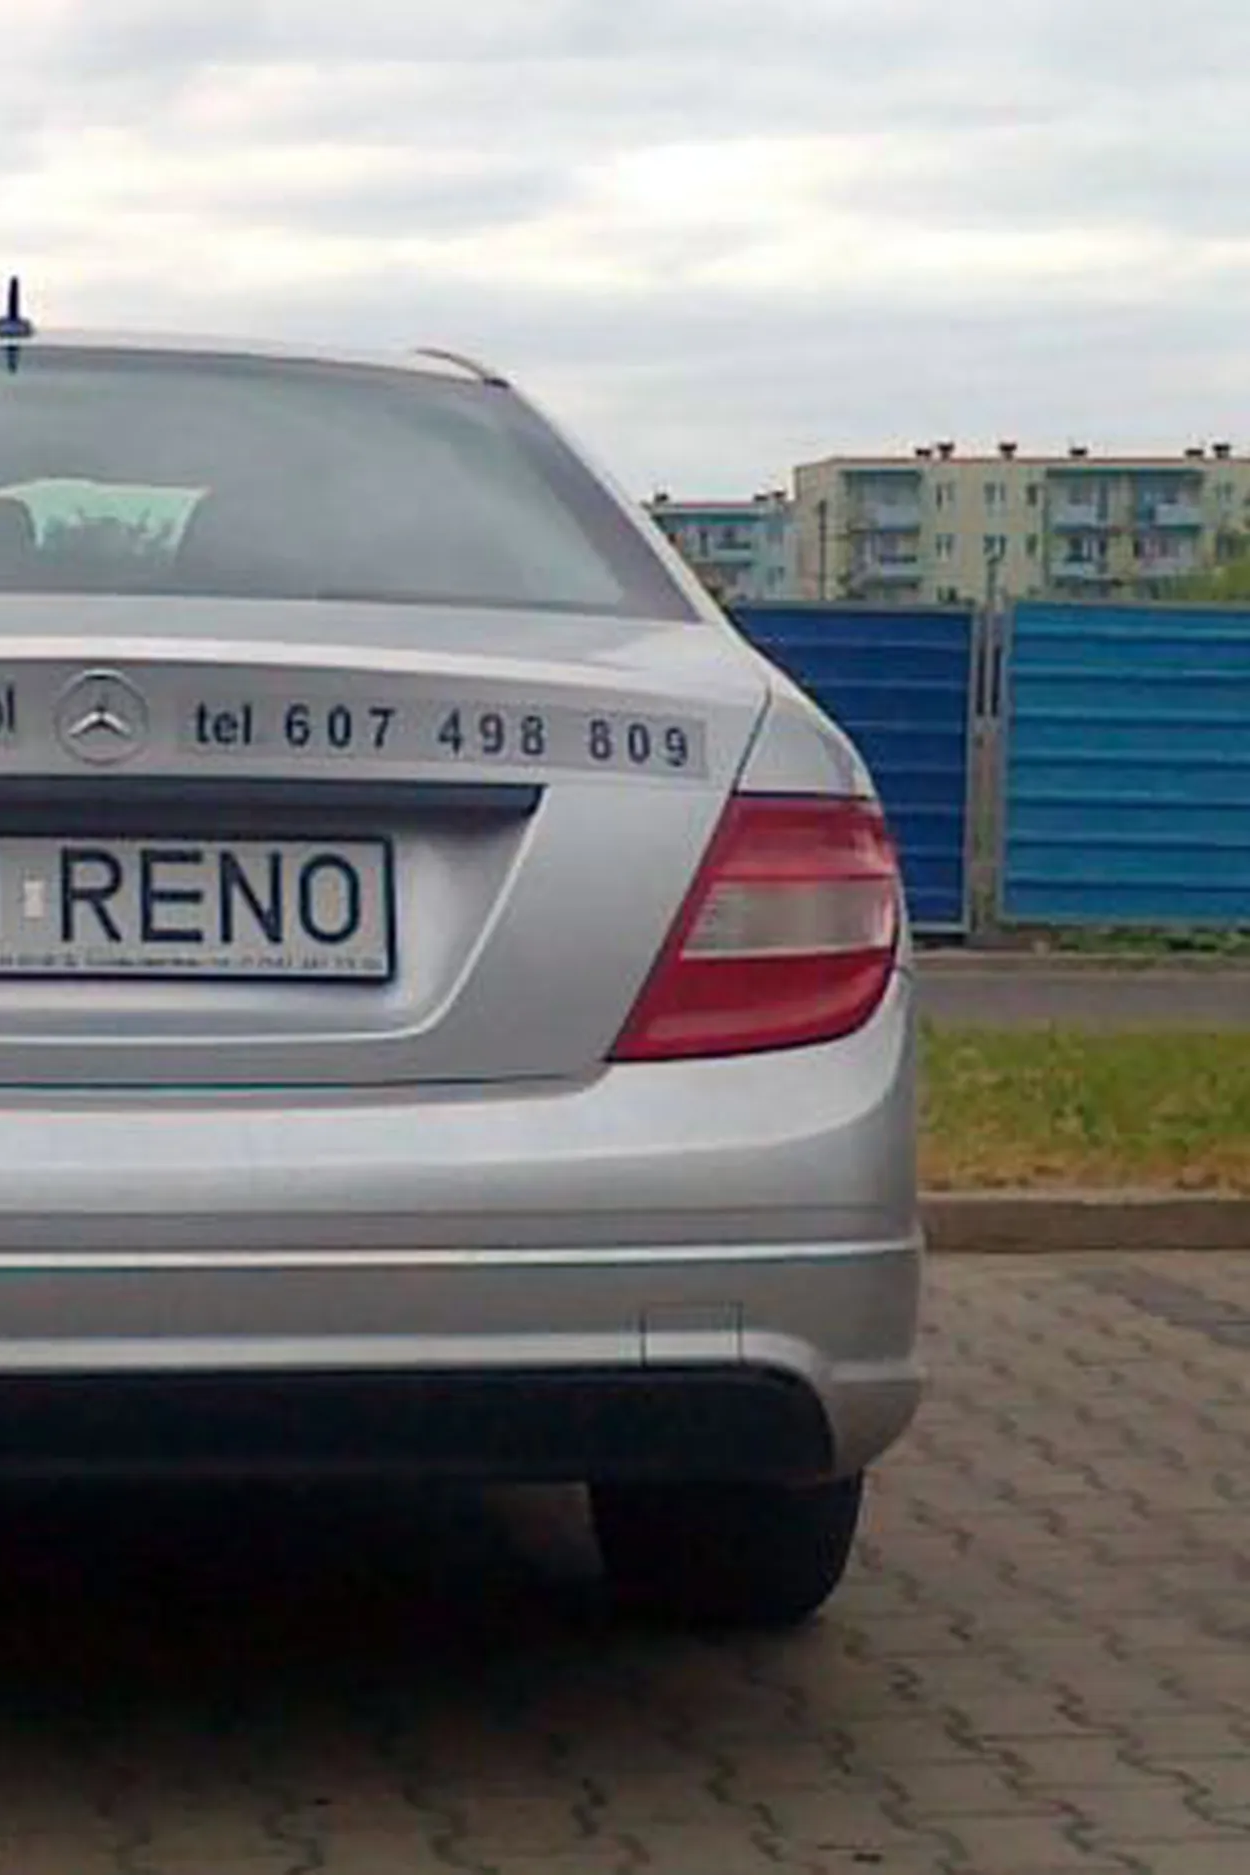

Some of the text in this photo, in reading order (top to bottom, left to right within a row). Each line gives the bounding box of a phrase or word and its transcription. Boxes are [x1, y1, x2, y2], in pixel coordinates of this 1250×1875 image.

[284, 704, 396, 749] 607
[437, 708, 546, 756] 498
[588, 718, 690, 768] 809
[59, 847, 362, 944] RENO
